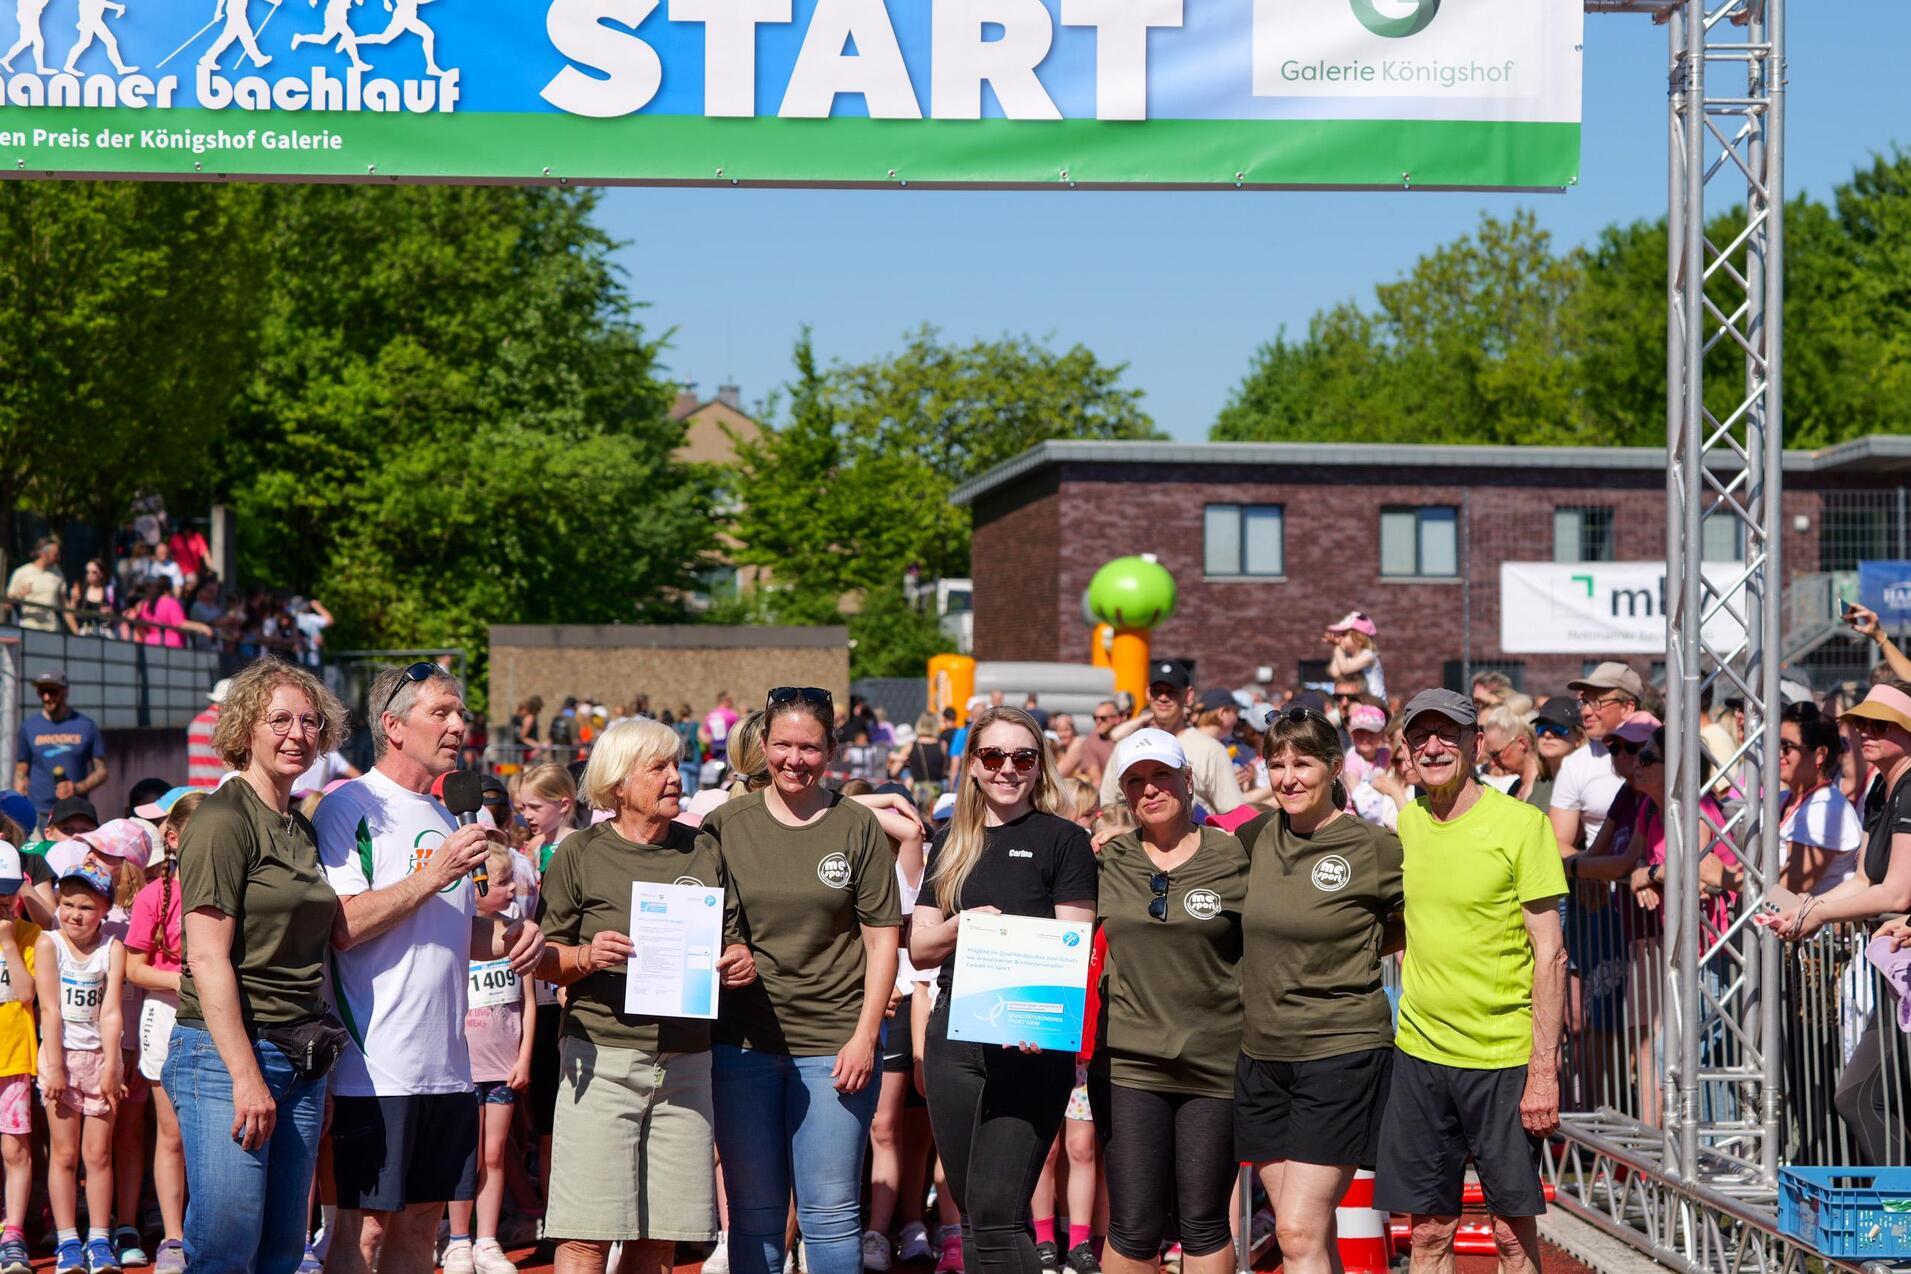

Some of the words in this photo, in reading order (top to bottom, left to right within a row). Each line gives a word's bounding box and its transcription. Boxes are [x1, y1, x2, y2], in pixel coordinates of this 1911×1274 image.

[539, 0, 1183, 120] START
[1281, 60, 1375, 81] Galerie
[1383, 60, 1514, 87] Königshof
[0, 73, 177, 109] anner
[196, 65, 459, 112] bachlauf
[33, 129, 90, 148] Preis
[96, 129, 134, 148] der
[140, 129, 256, 153] Königshof
[261, 131, 343, 149] Galerie
[34, 733, 82, 746] BROOKS
[824, 860, 847, 871] me
[1320, 862, 1343, 875] me
[1317, 871, 1342, 882] sport
[1191, 894, 1215, 903] me
[1191, 901, 1216, 911] sport
[470, 969, 516, 992] 1409
